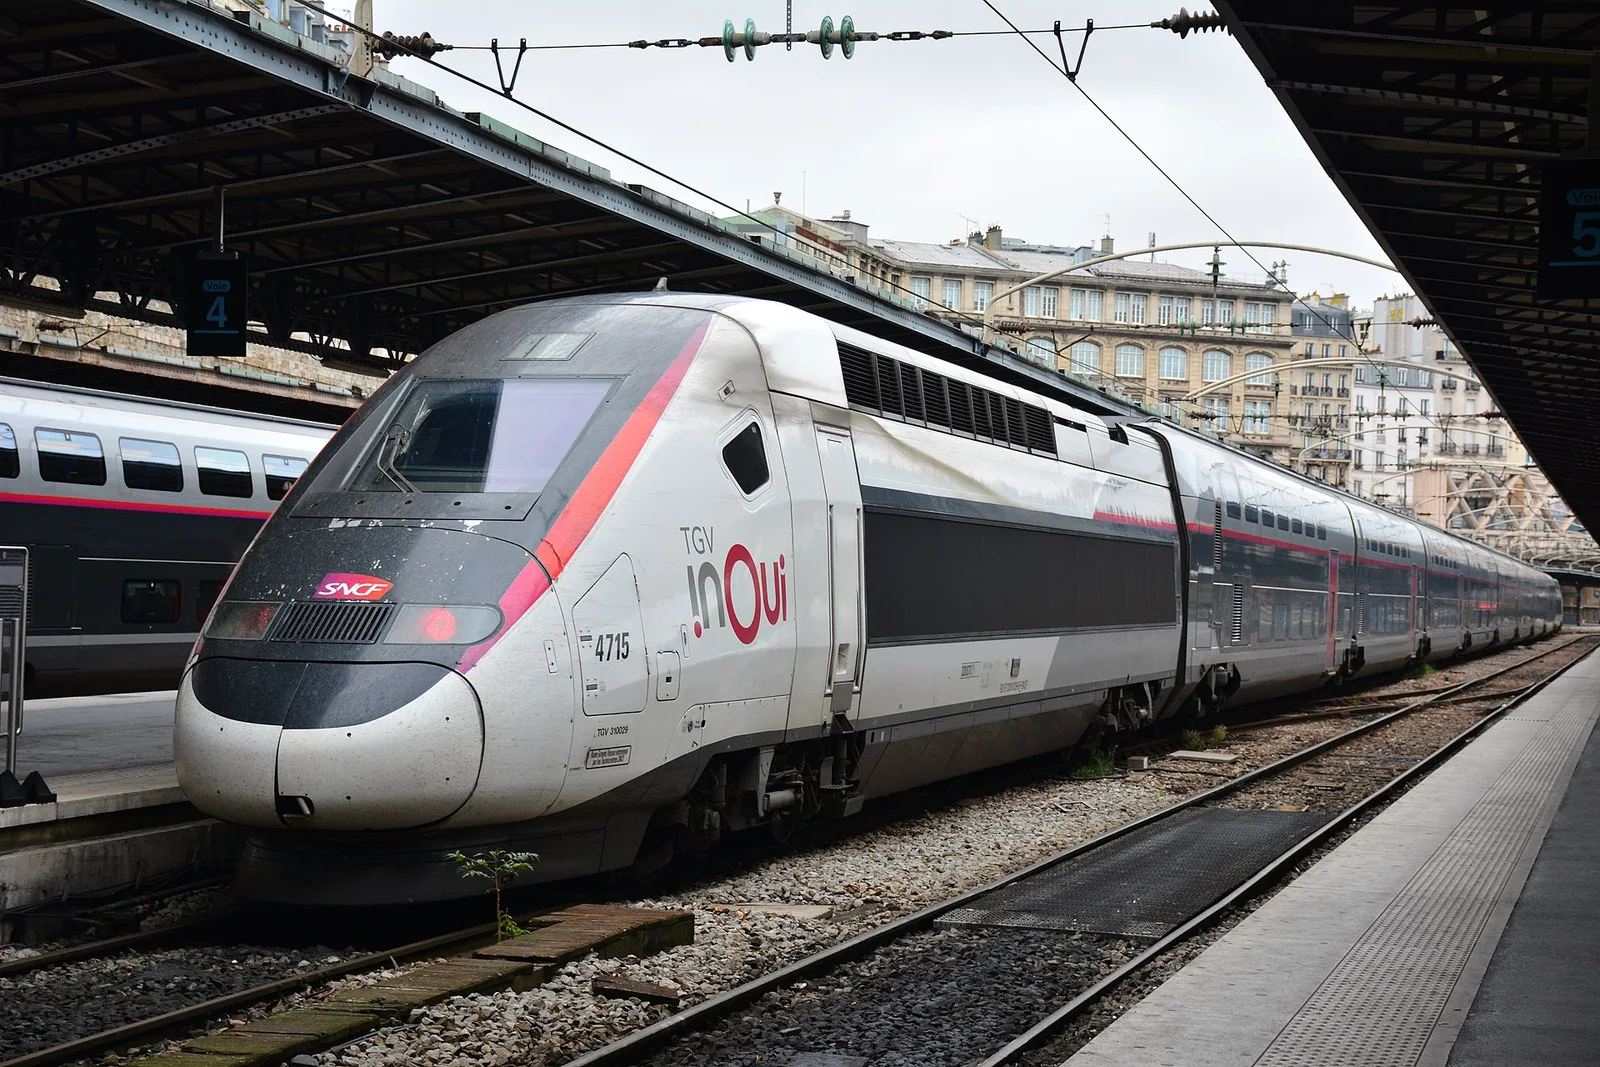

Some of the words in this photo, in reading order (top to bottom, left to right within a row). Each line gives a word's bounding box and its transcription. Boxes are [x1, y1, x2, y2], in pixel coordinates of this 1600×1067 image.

[1572, 190, 1600, 204] Voi
[1572, 212, 1600, 257] 5
[206, 281, 228, 290] Voie
[206, 296, 227, 327] 4
[680, 526, 713, 554] TGV
[318, 582, 388, 596] SNCF
[595, 632, 629, 662] 4715
[597, 727, 609, 736] TGV
